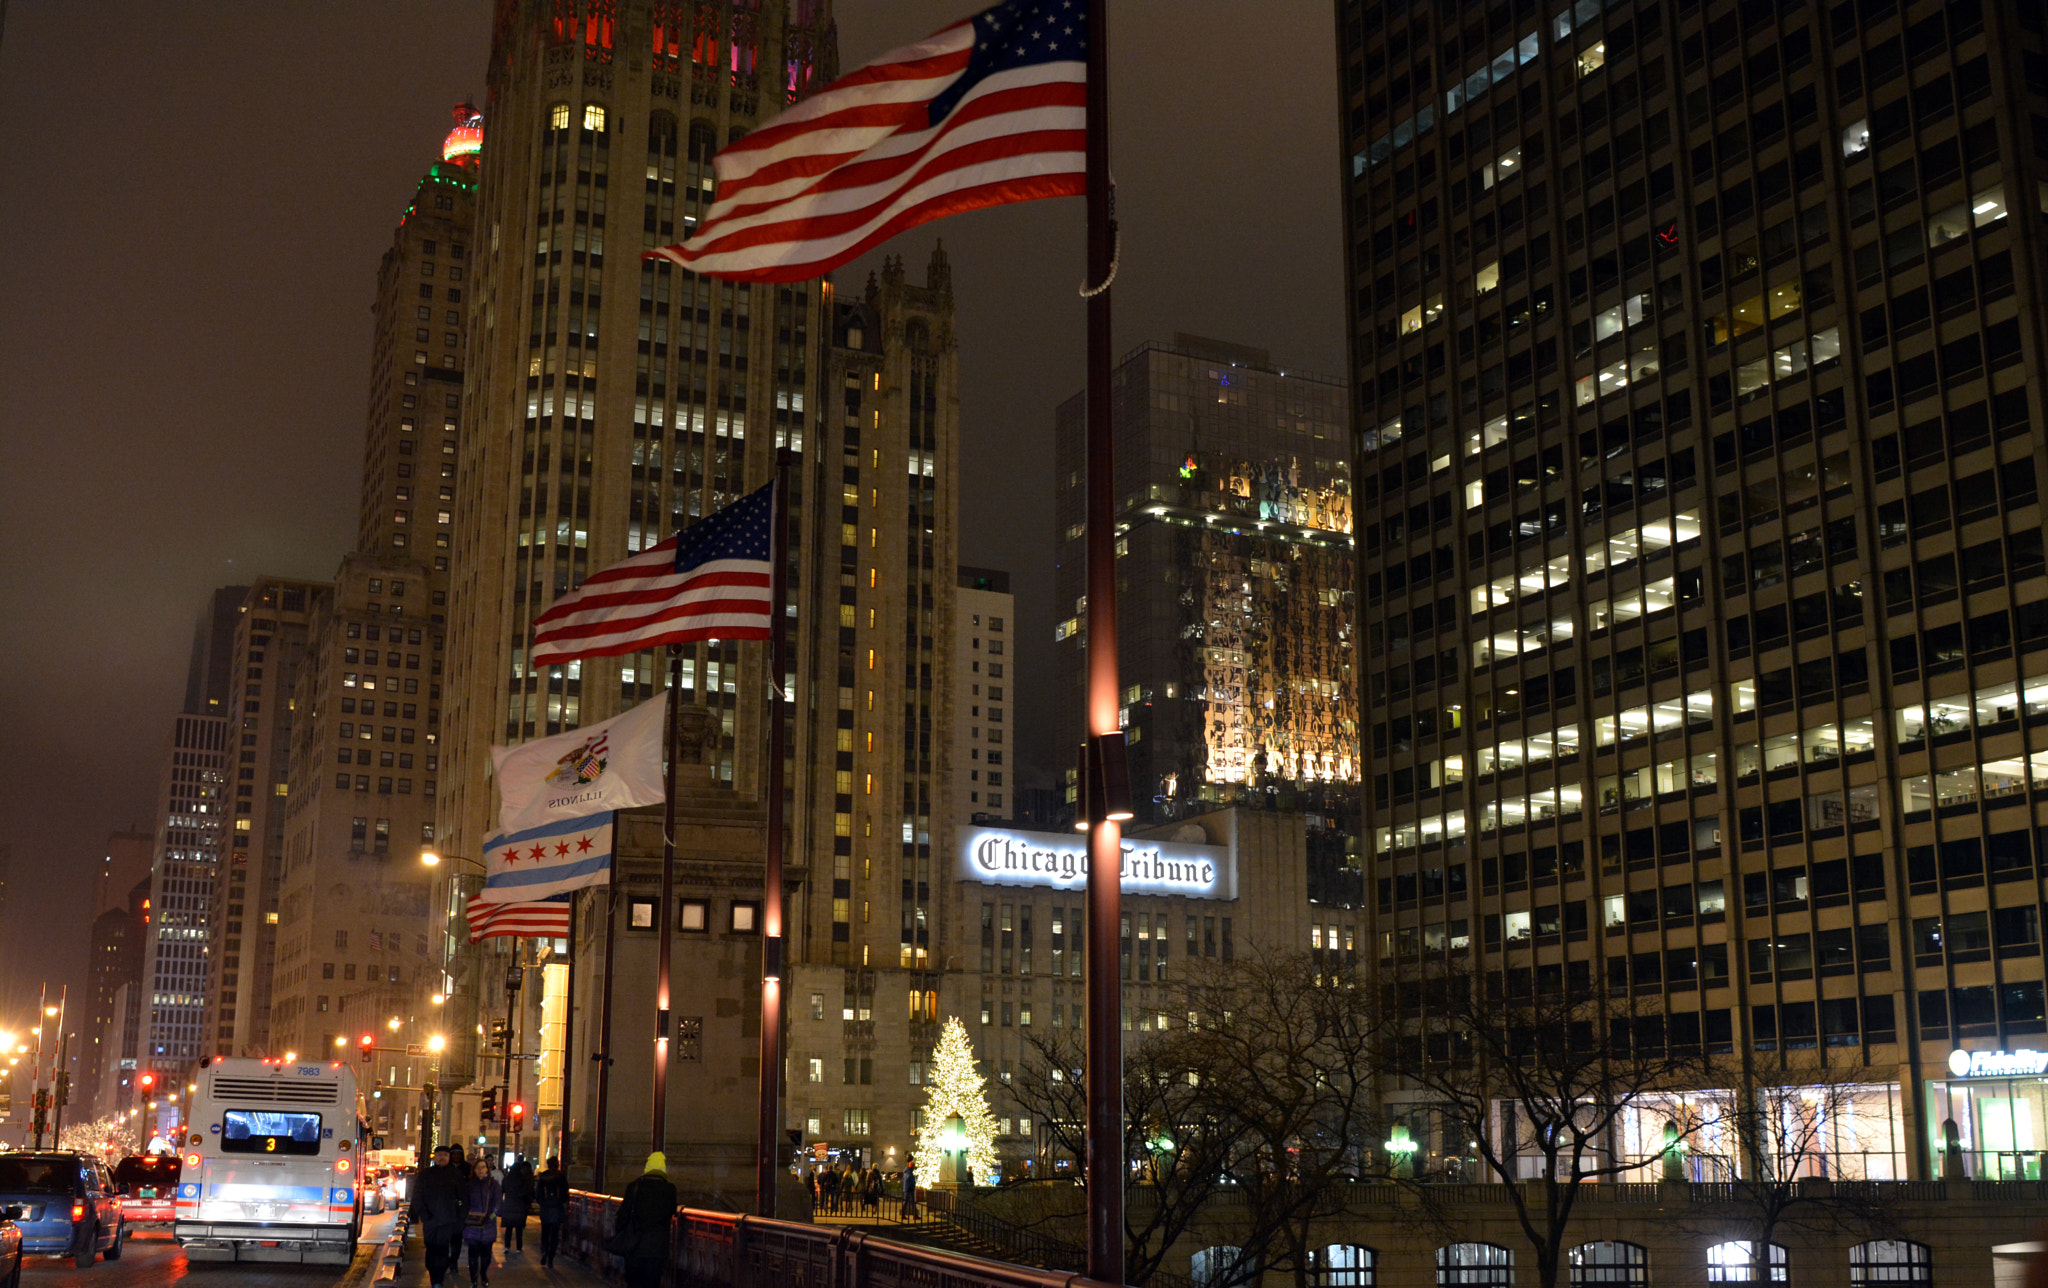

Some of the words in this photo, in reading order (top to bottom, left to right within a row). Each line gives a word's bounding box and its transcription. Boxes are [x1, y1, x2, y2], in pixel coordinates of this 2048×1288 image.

[977, 838, 1089, 879] Chicago
[1119, 846, 1215, 883] Tribune
[1970, 1049, 2048, 1073] Fidelity
[297, 1066, 320, 1076] 7983
[266, 1137, 276, 1152] 3
